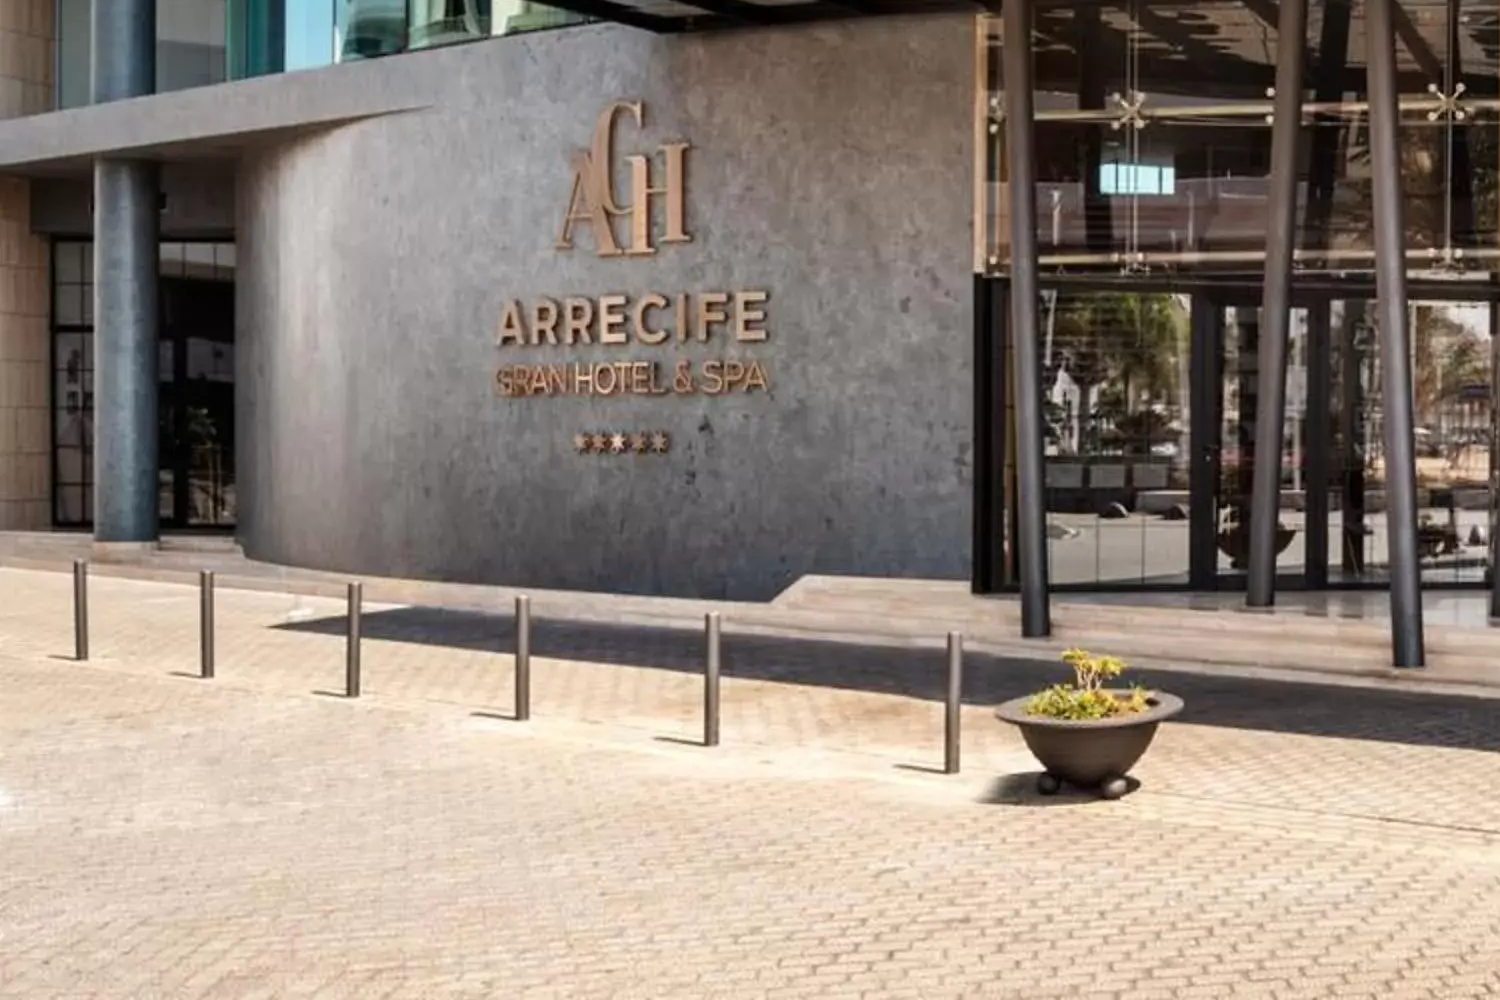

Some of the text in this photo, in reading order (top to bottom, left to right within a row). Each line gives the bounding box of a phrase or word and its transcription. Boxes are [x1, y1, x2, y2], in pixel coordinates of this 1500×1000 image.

[497, 291, 769, 346] ARRECIFE
[574, 360, 666, 394] HOTEL
[672, 360, 693, 393] &
[700, 360, 769, 393] SPA
